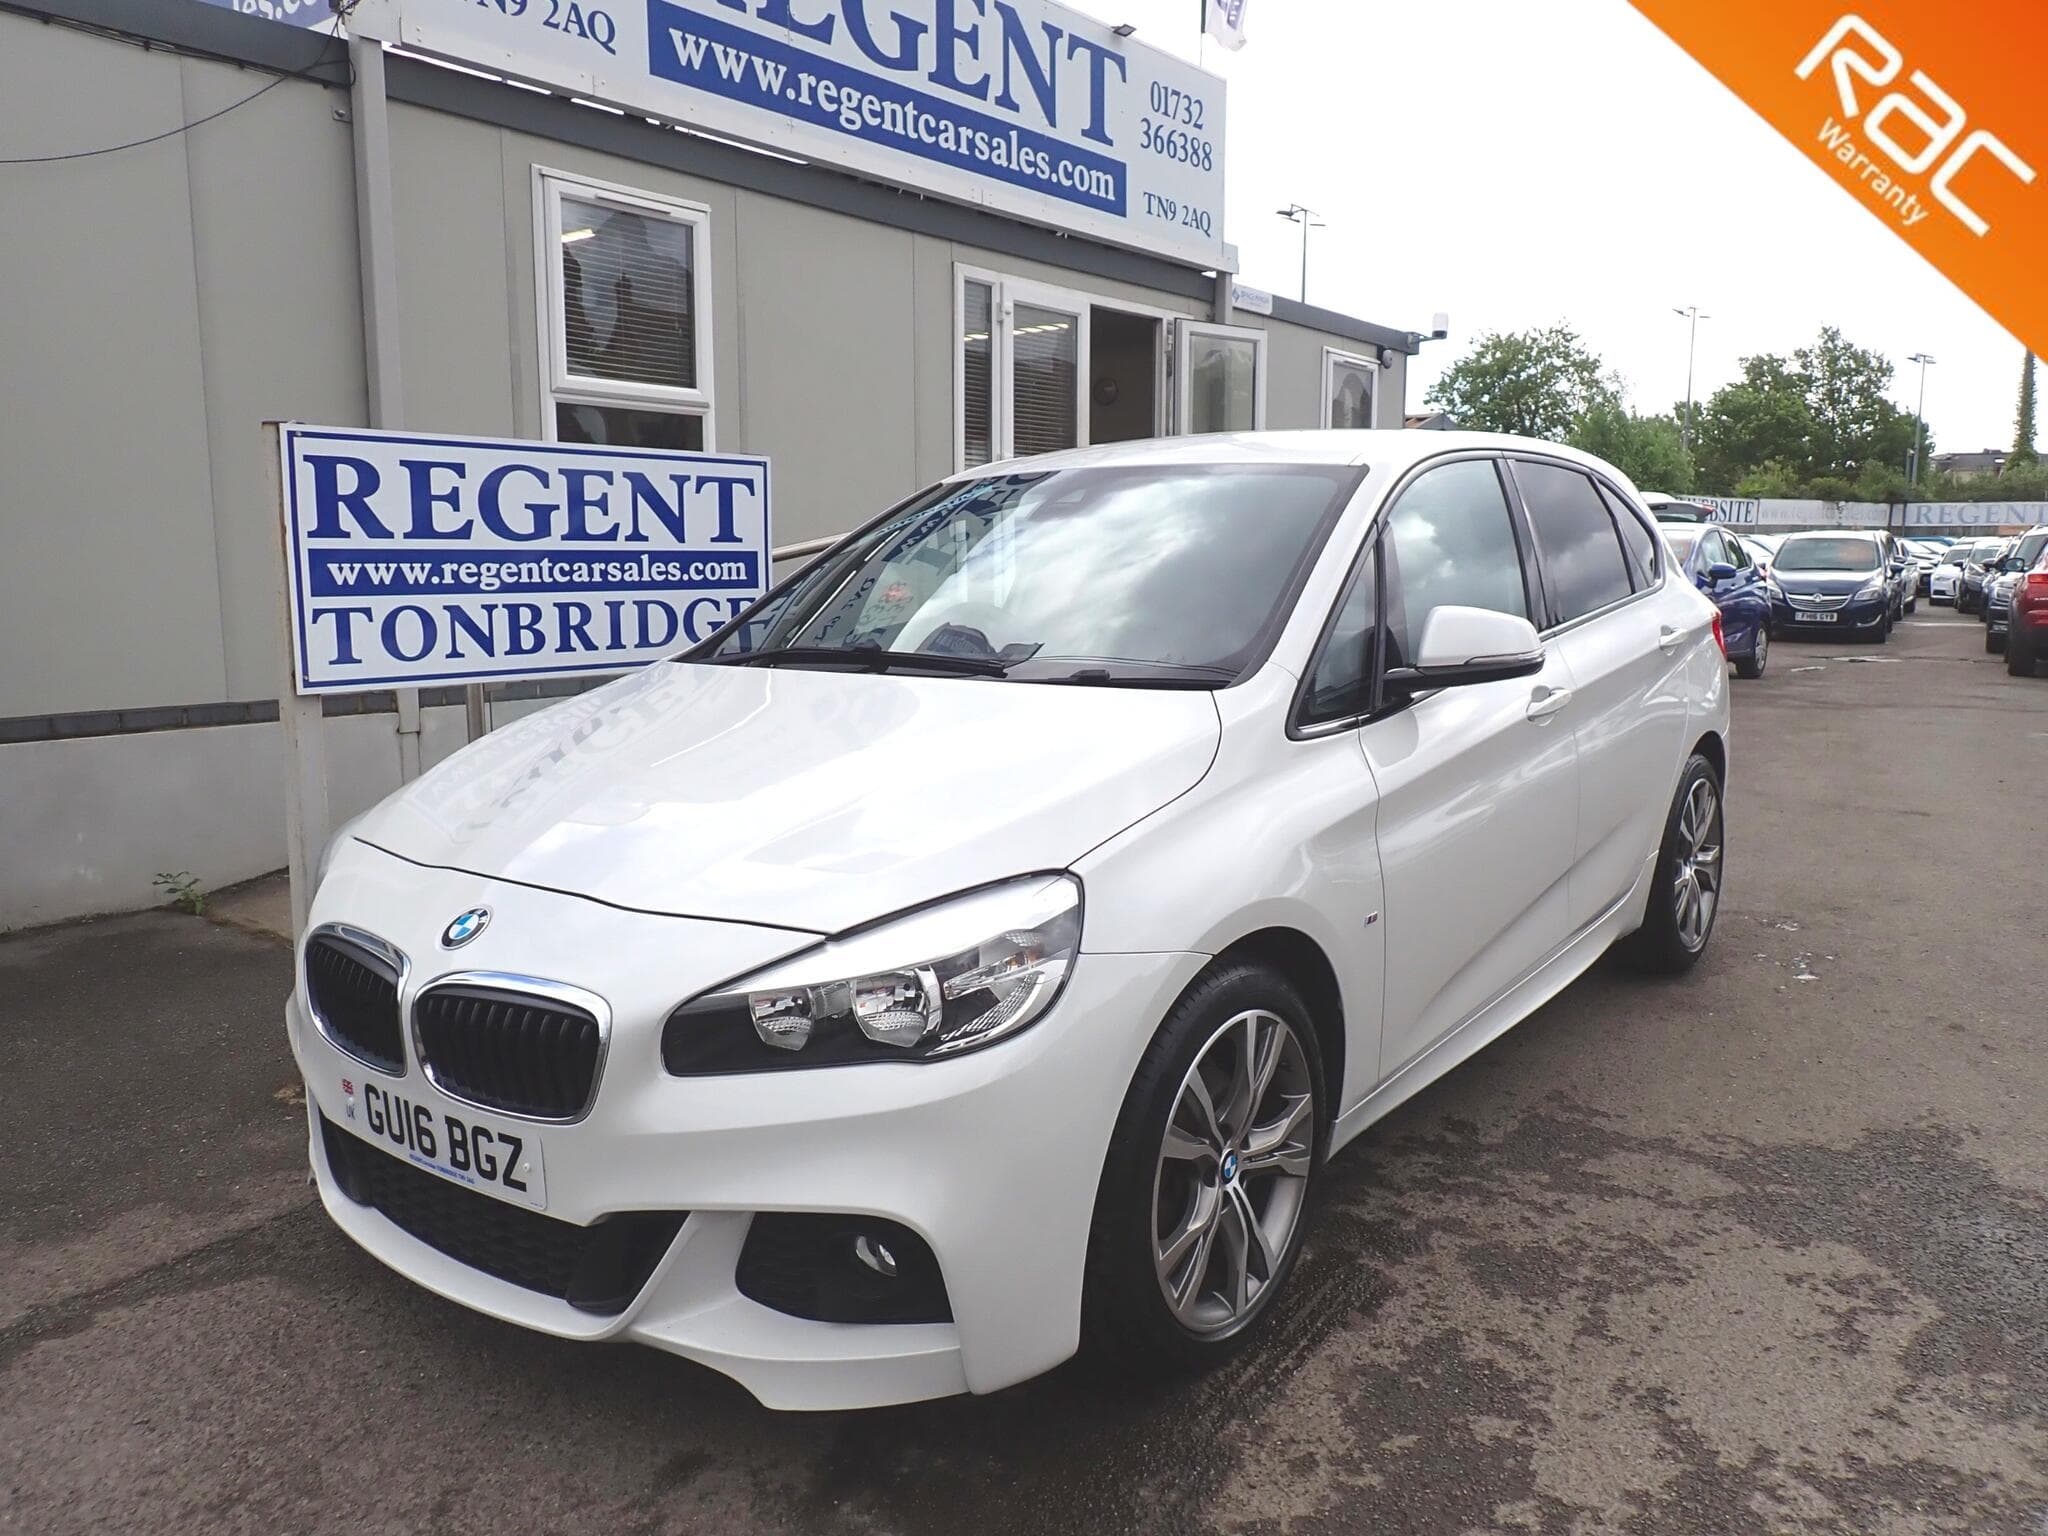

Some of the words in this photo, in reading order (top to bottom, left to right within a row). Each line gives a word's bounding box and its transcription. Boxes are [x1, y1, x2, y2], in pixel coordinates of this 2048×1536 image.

[541, 0, 617, 56] 2AQ
[668, 27, 1116, 200] www.regentcarsales.com
[1149, 80, 1205, 129] 01732
[1139, 117, 1213, 173] 366388
[1143, 190, 1178, 221] TN9
[1181, 204, 1212, 238] 2AQ
[303, 454, 755, 544] REGENT
[327, 554, 747, 591] www.regentcarsales.com
[364, 1083, 437, 1159] GU16
[445, 1115, 527, 1193] BGZ
